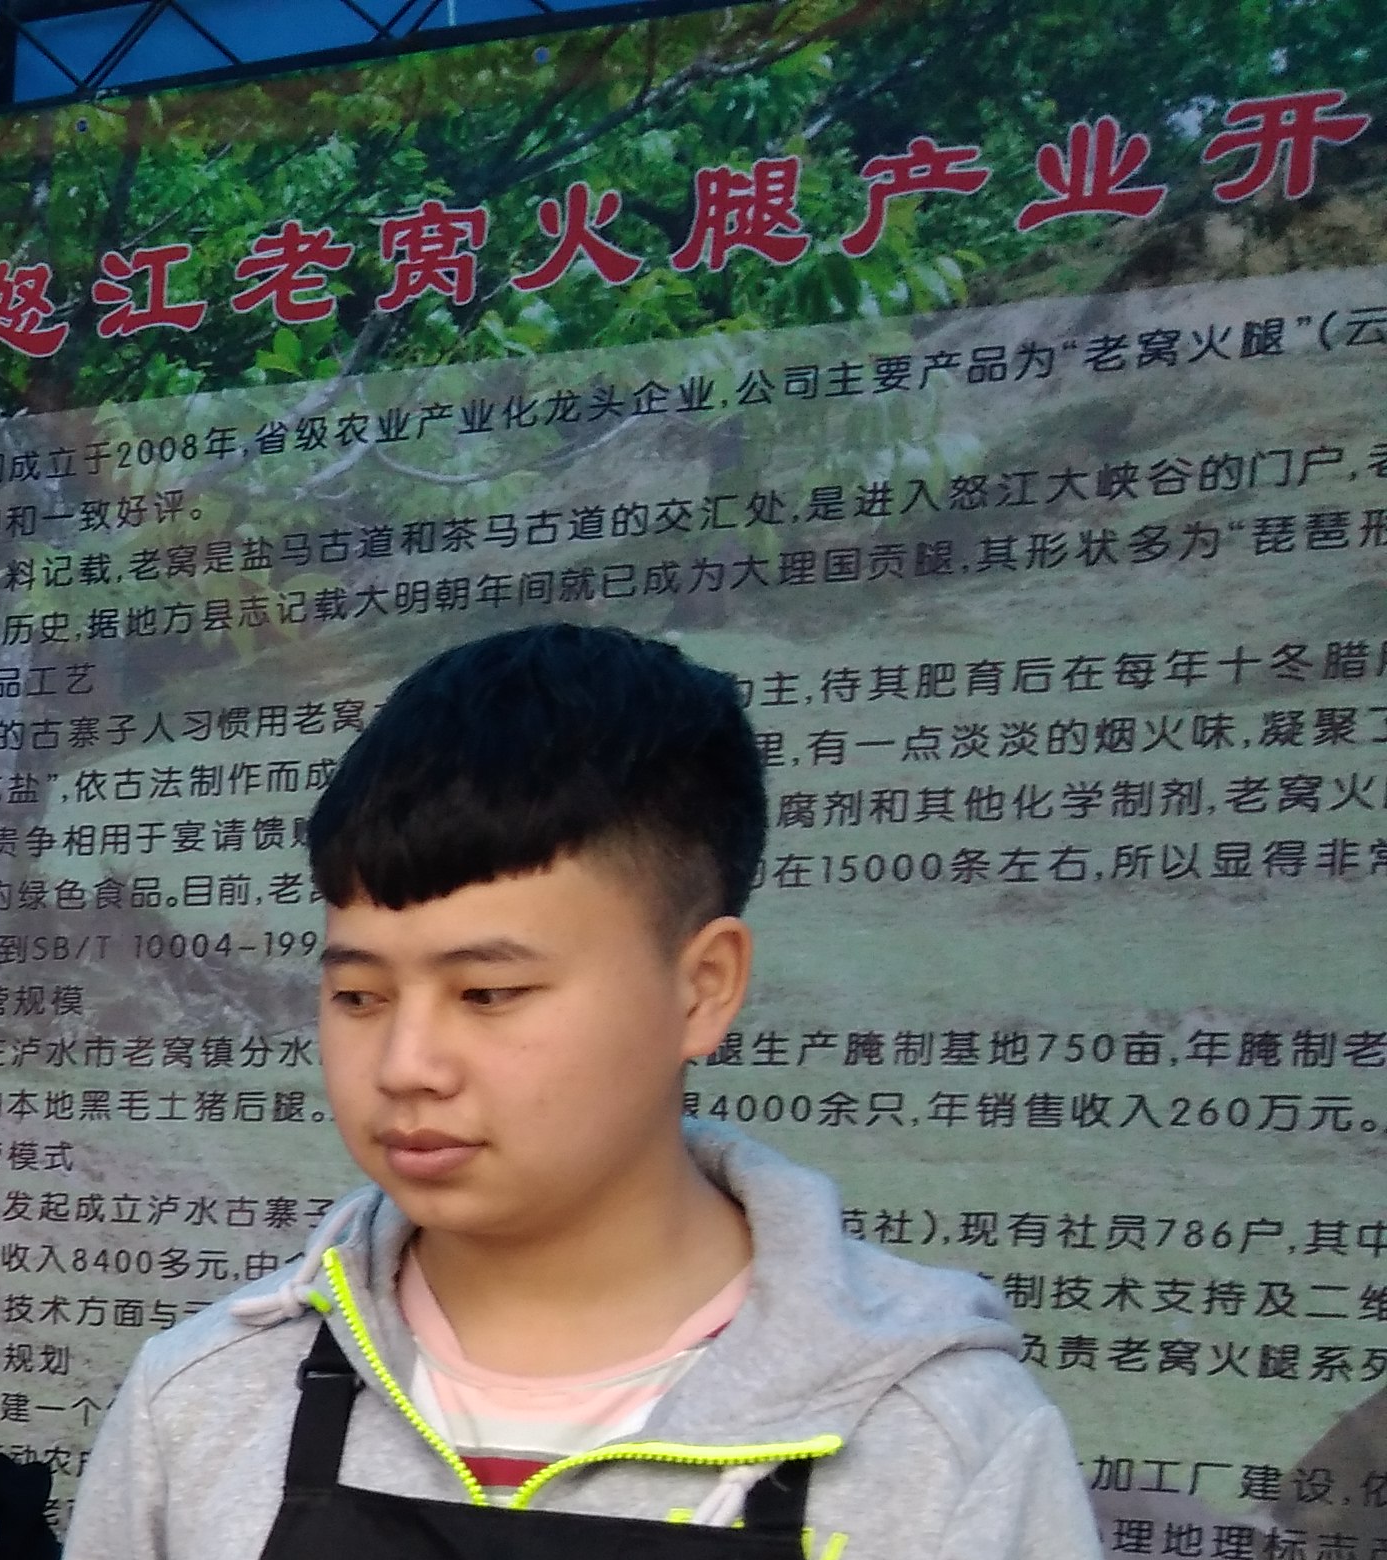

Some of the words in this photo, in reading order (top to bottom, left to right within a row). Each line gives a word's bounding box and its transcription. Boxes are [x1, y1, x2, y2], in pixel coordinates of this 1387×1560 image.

[776, 771, 1387, 832] 腐剂和其他化学制剂，老窝火
[132, 930, 325, 961] 10004-199
[686, 1030, 1387, 1068] 腿生产腌制基地750亩，年腌制老
[979, 1268, 1387, 1324] 制技术支持及二维
[1077, 1453, 1387, 1511] 加工厂建设，依
